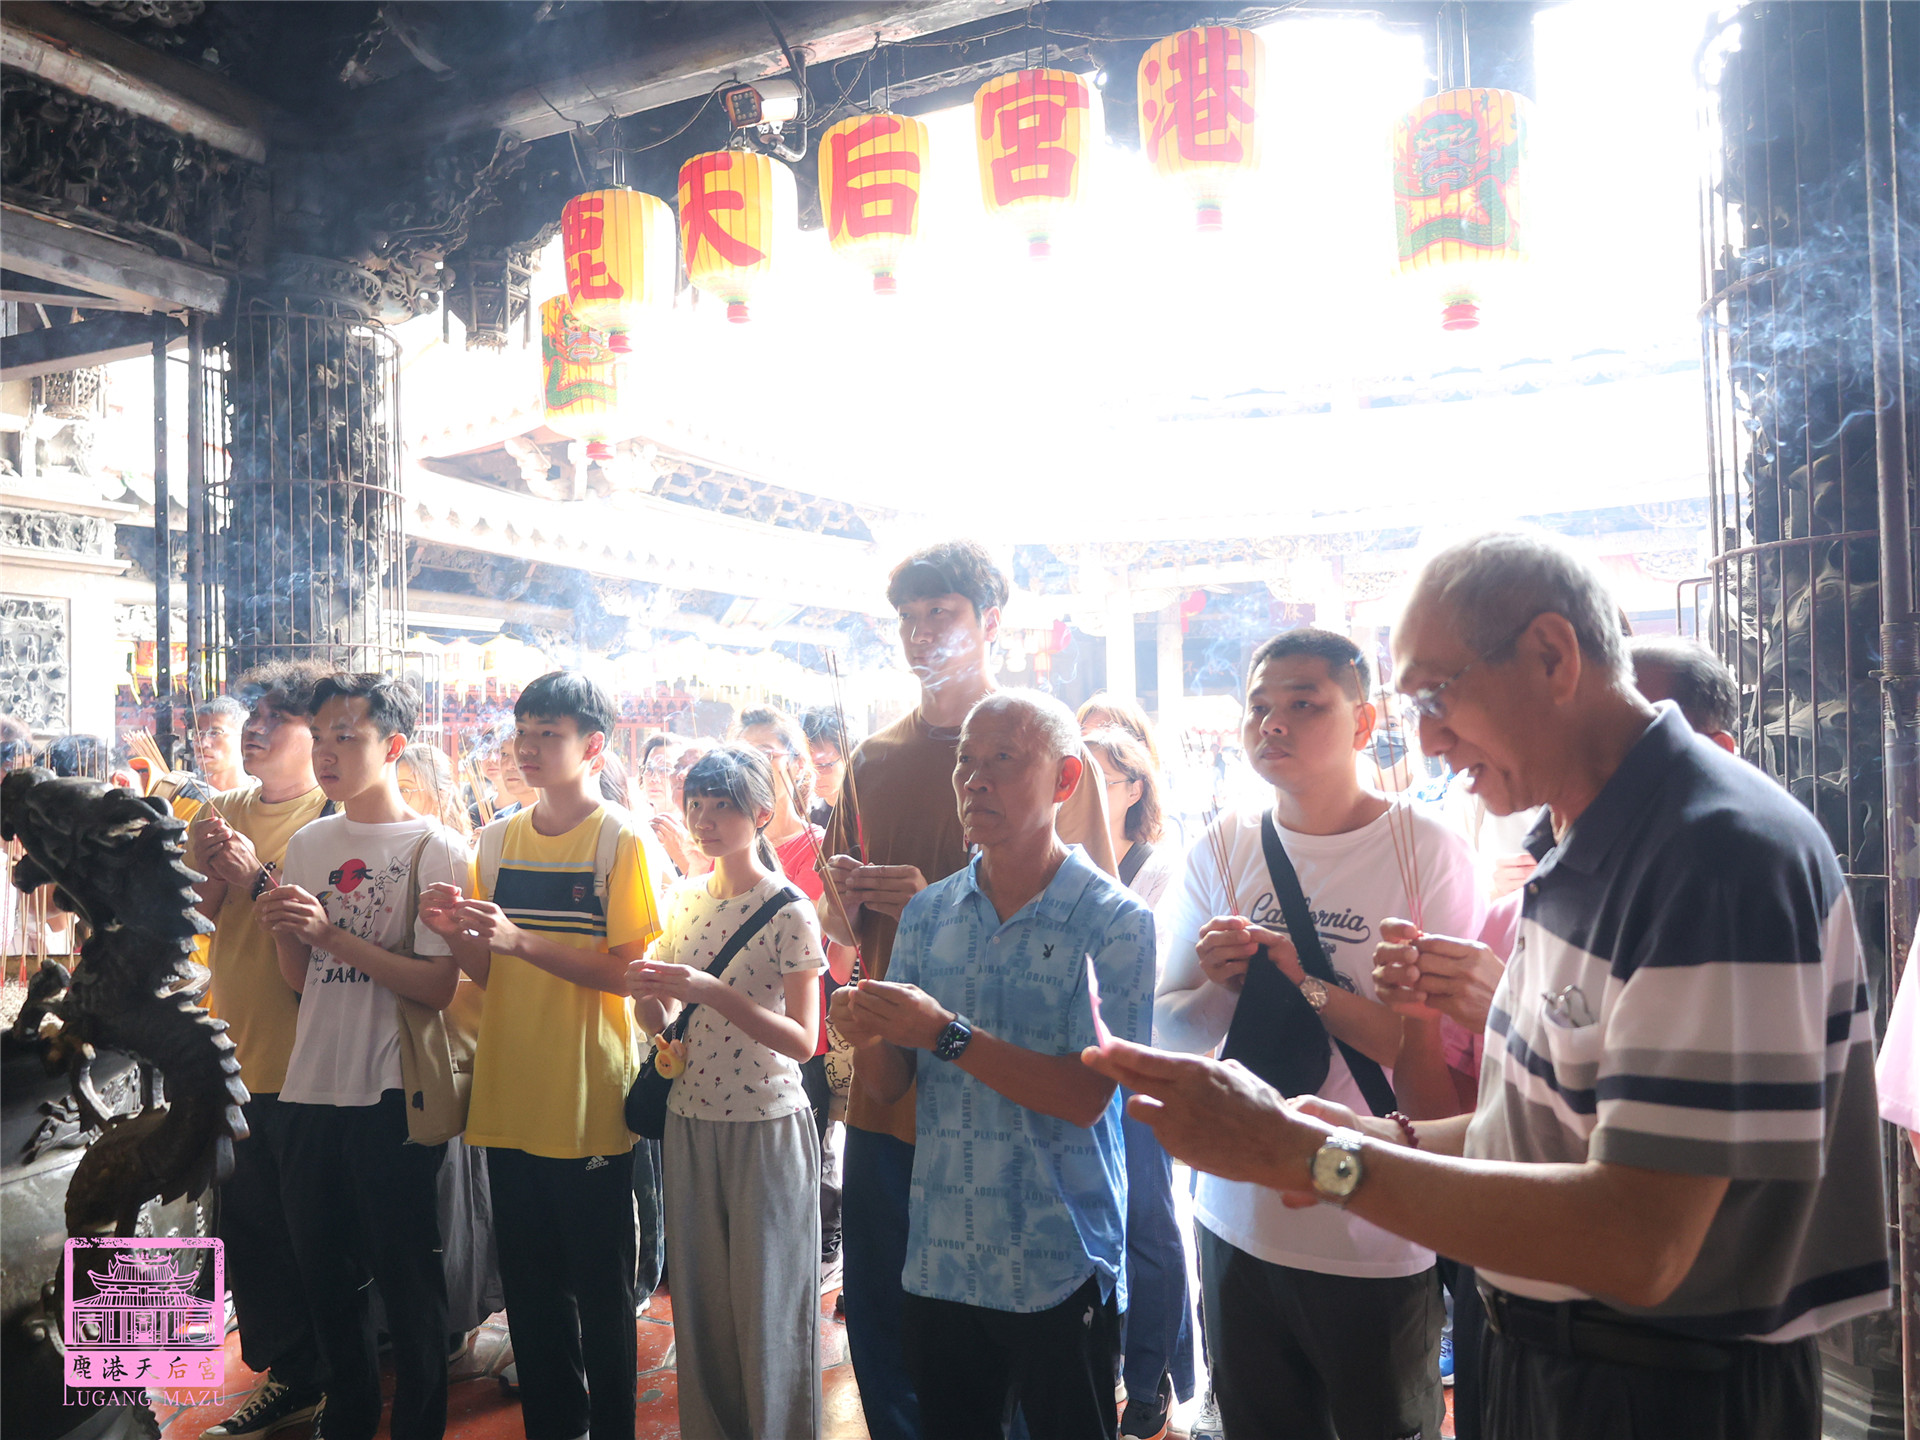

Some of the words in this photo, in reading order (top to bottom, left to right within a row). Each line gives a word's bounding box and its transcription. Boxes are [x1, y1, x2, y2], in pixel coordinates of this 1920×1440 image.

[1142, 26, 1260, 164] 港
[980, 69, 1090, 207] 宮
[829, 116, 921, 243] 后
[1250, 891, 1368, 933] Caornia
[964, 977, 976, 1018] PLAYBOY
[1022, 971, 1064, 987] PLAYBOY
[962, 1086, 972, 1129] PLAYBOY
[963, 1140, 974, 1184] PLAYBOY
[964, 1197, 975, 1242] PLAYBOY
[929, 1237, 966, 1251] PLAYBOY
[1023, 1248, 1071, 1261] PLAYBOY
